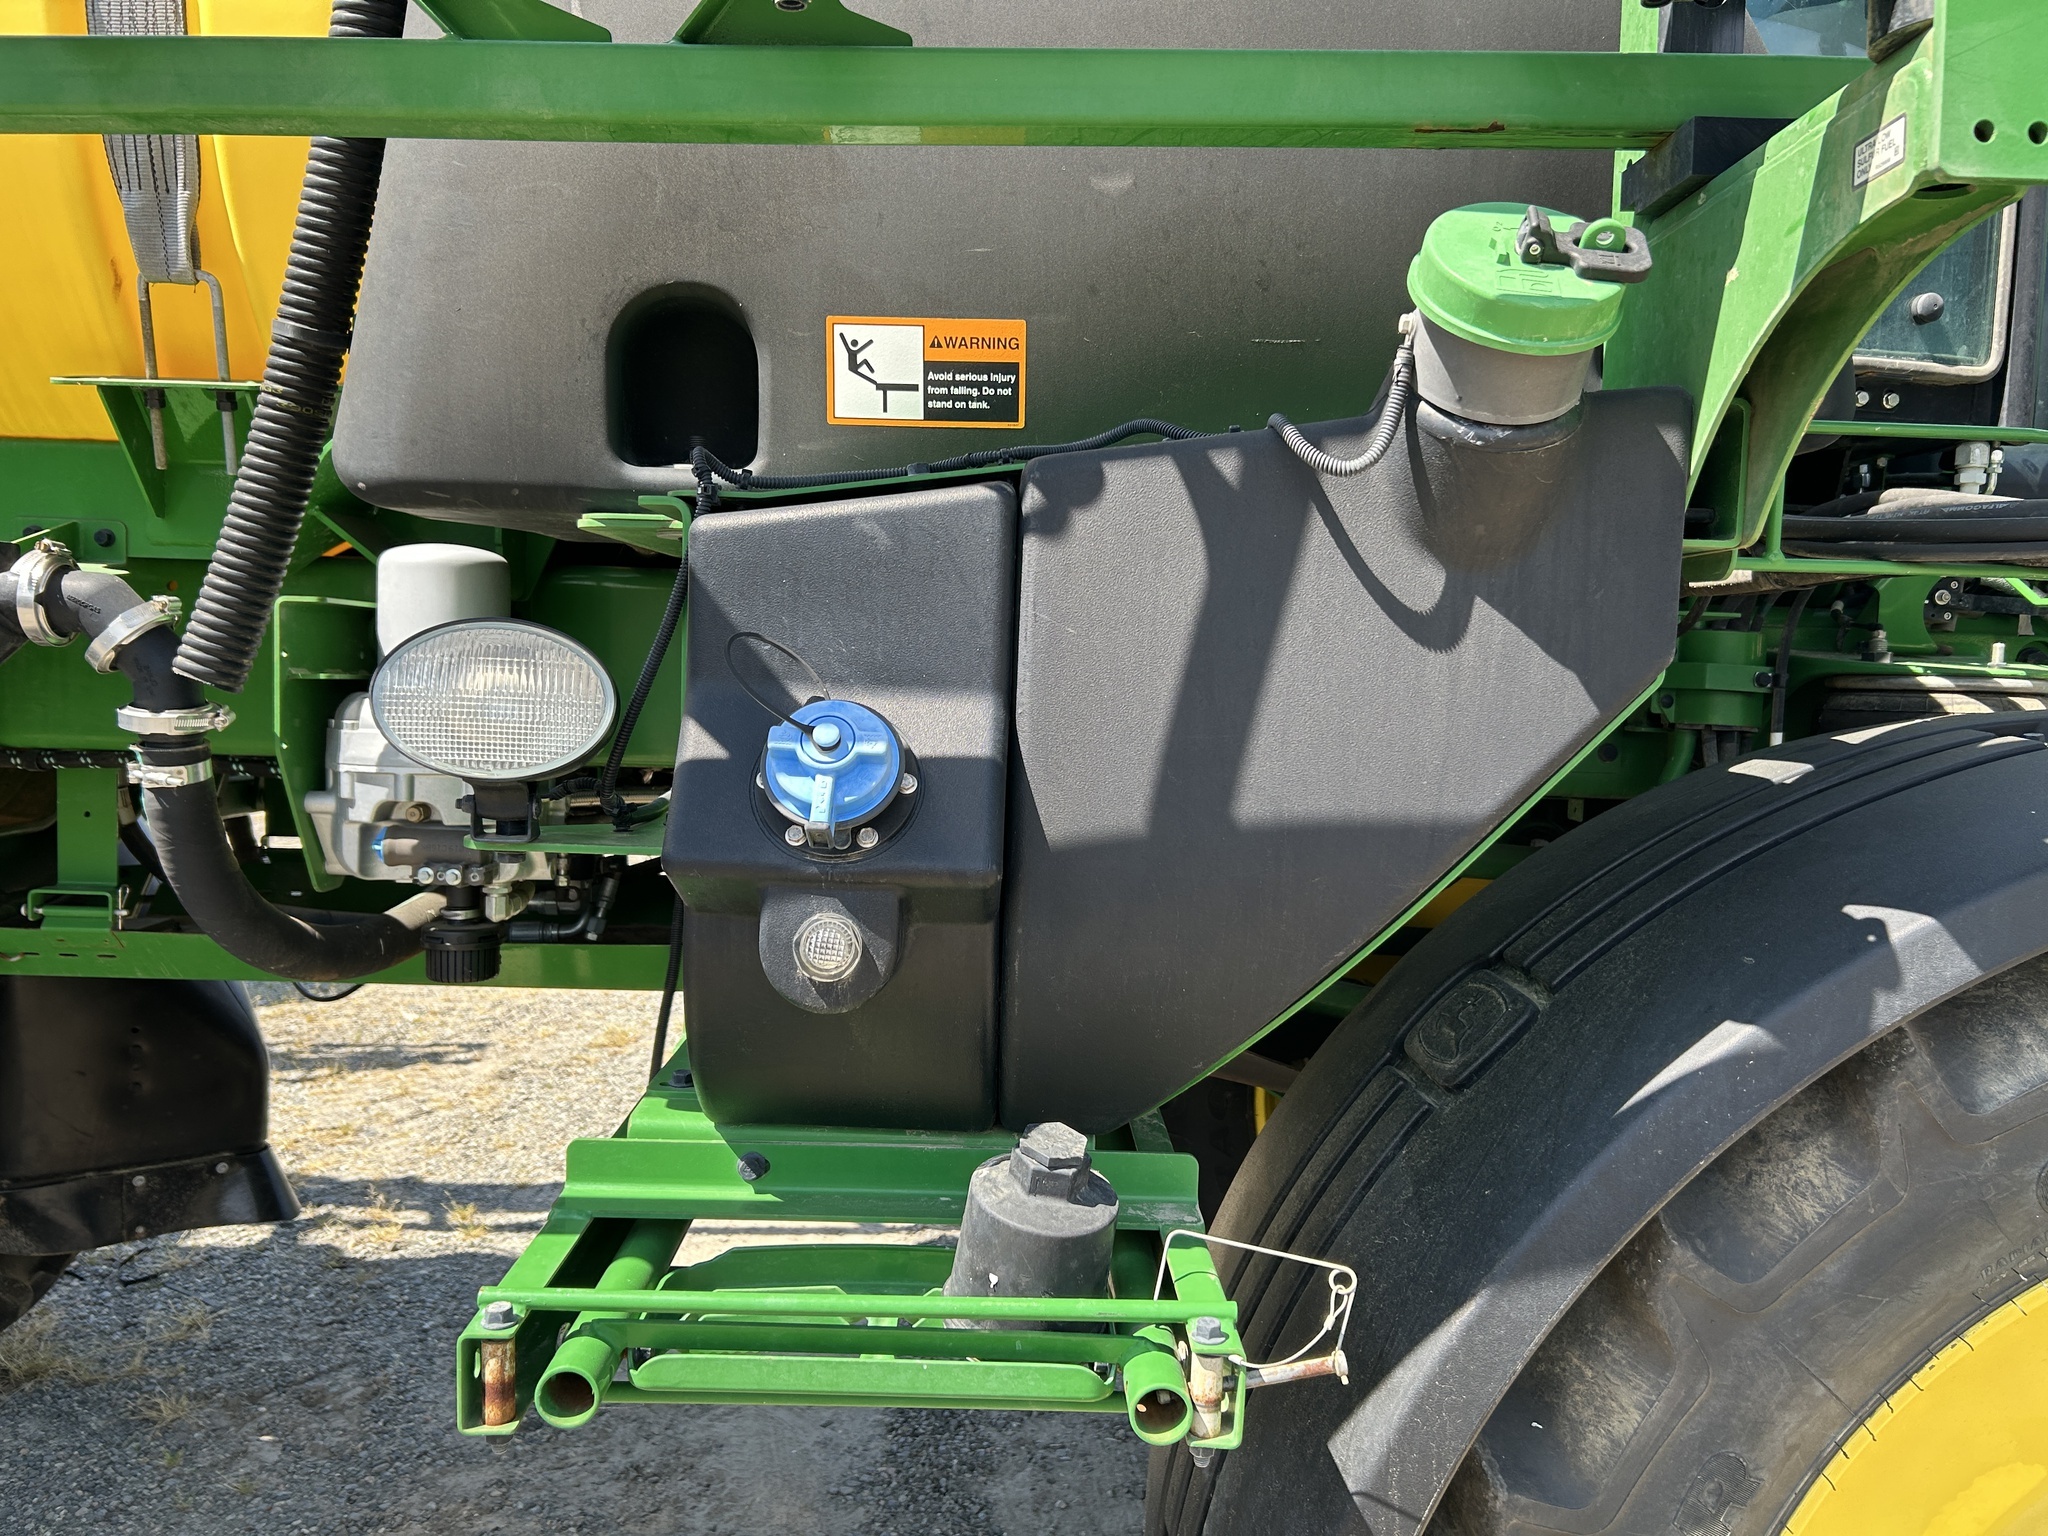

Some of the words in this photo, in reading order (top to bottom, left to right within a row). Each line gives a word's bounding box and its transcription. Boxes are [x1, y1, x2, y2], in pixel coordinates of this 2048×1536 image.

[1858, 139, 1877, 156] ULTRA
[1881, 139, 1896, 153] FUEL
[943, 336, 1020, 350] WARNING
[927, 371, 953, 381] Avoid
[954, 372, 989, 382] serious
[927, 385, 949, 395] from
[950, 385, 980, 397] falling.
[982, 386, 995, 396] Do
[997, 386, 1012, 396] not
[927, 399, 953, 409] stand
[954, 400, 966, 409] on
[968, 400, 990, 409] tank.
